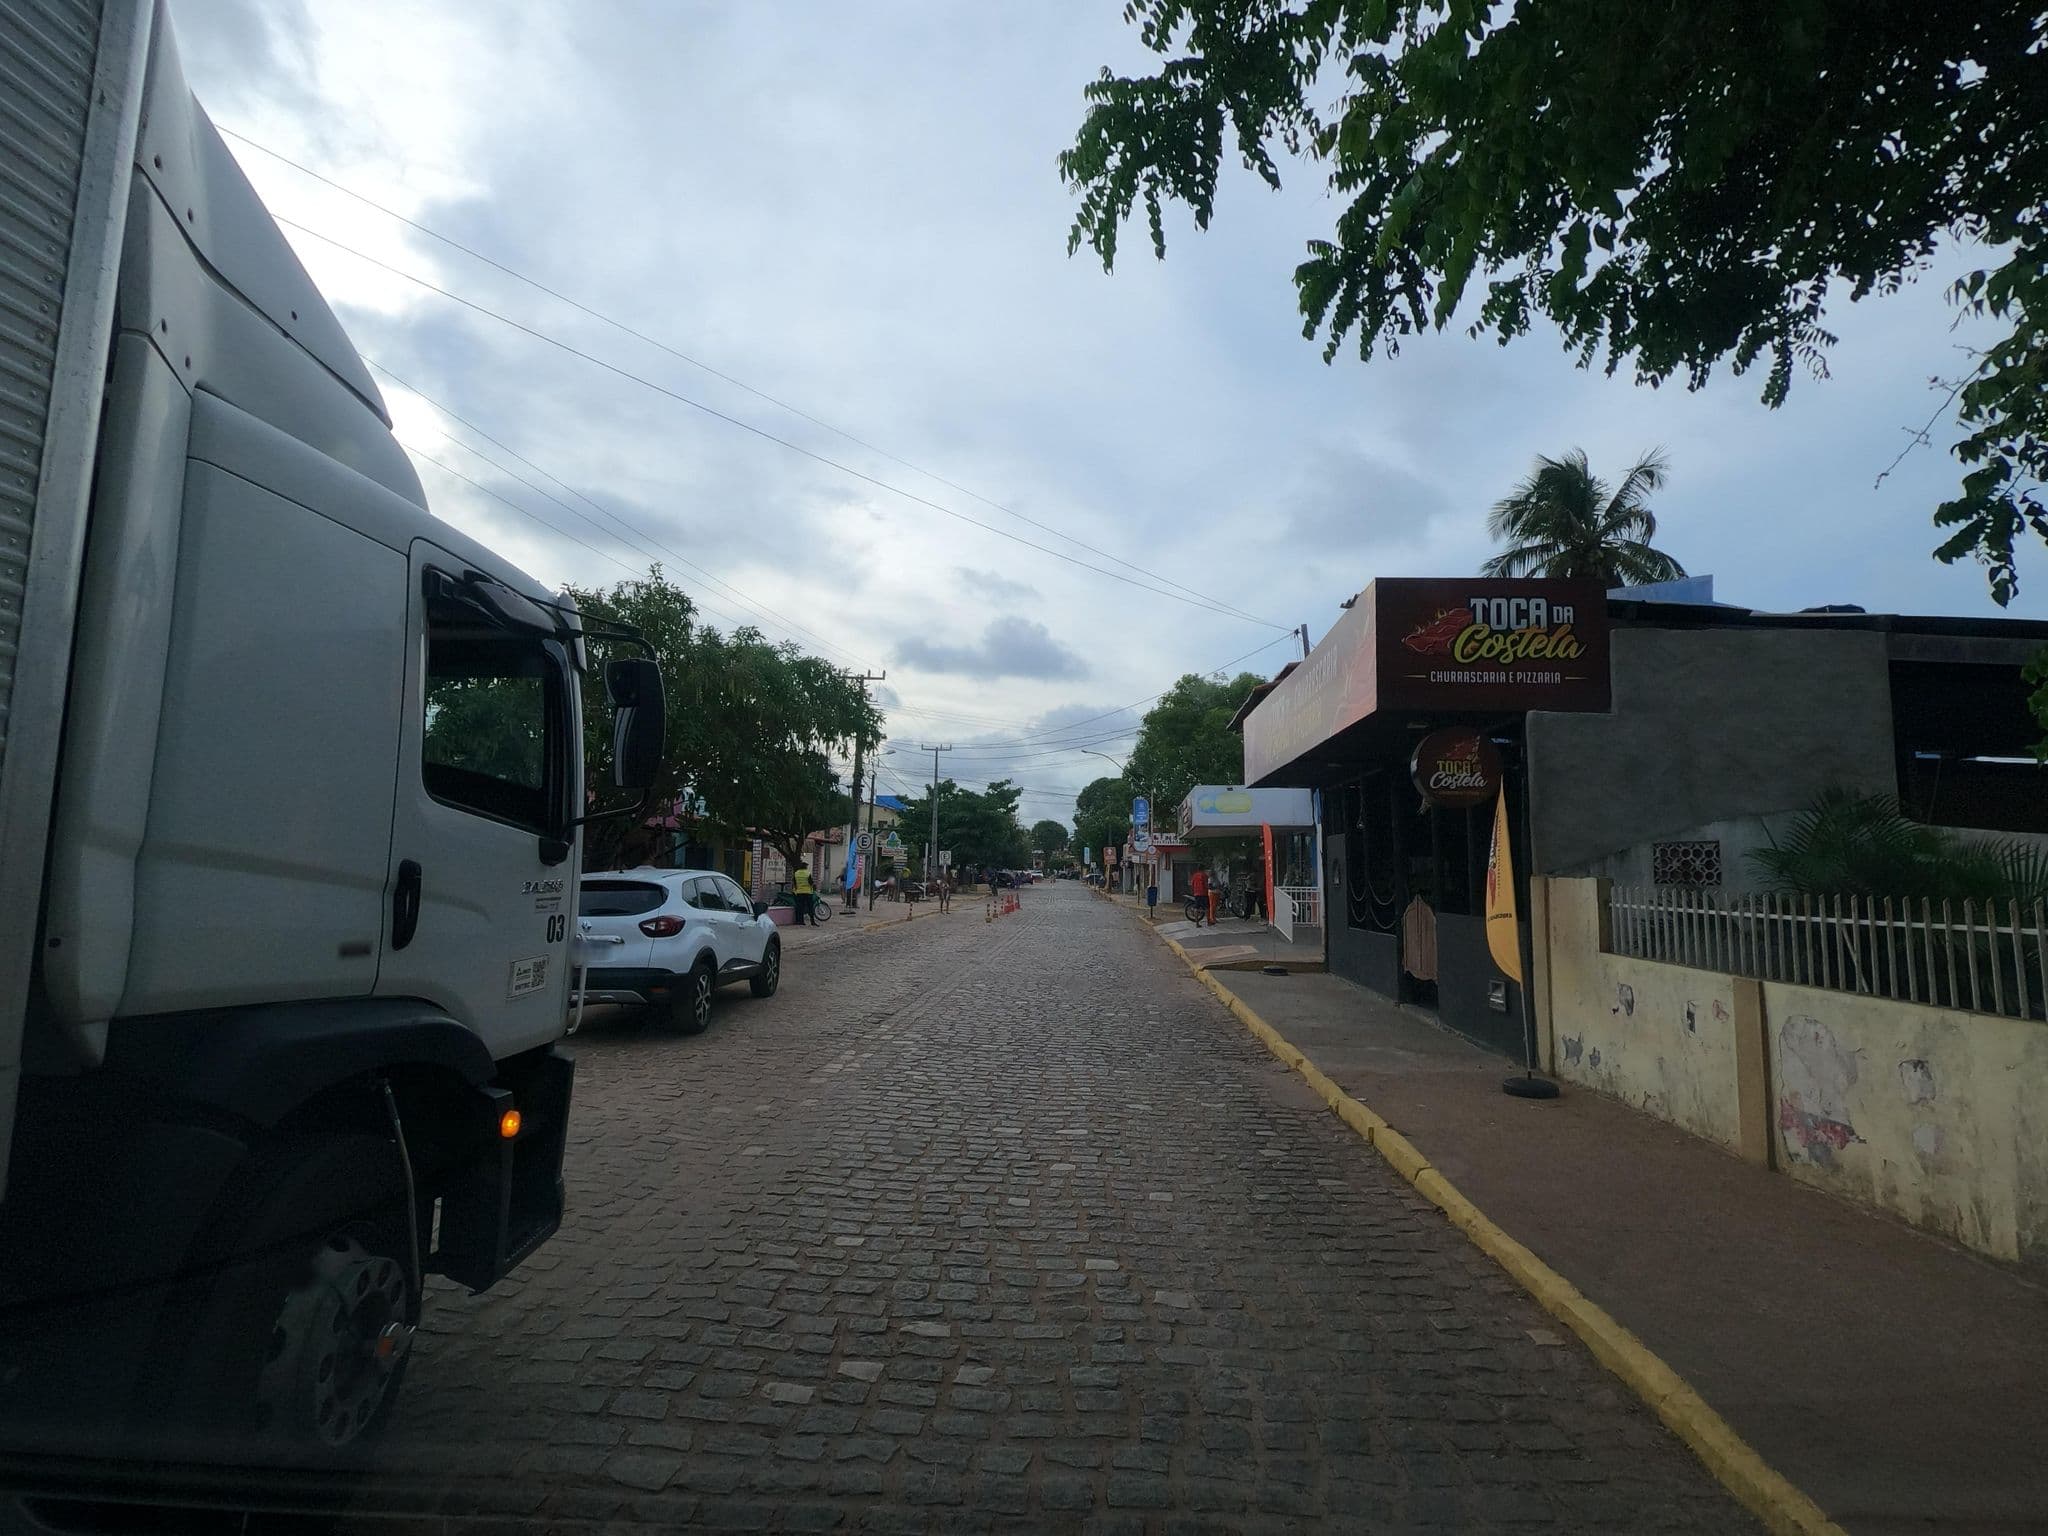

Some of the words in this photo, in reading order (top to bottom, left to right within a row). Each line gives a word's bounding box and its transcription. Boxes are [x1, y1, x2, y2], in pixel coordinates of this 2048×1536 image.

[1470, 598, 1547, 631] TOCA
[1553, 606, 1574, 624] DA
[1454, 624, 1586, 663] Costela
[1430, 671, 1506, 684] CHURRASCARIA
[1509, 672, 1514, 683] E
[1517, 672, 1561, 684] PIZZARIA
[1437, 760, 1471, 775] TOCA
[1430, 771, 1488, 789] Costela
[547, 915, 565, 943] 03
